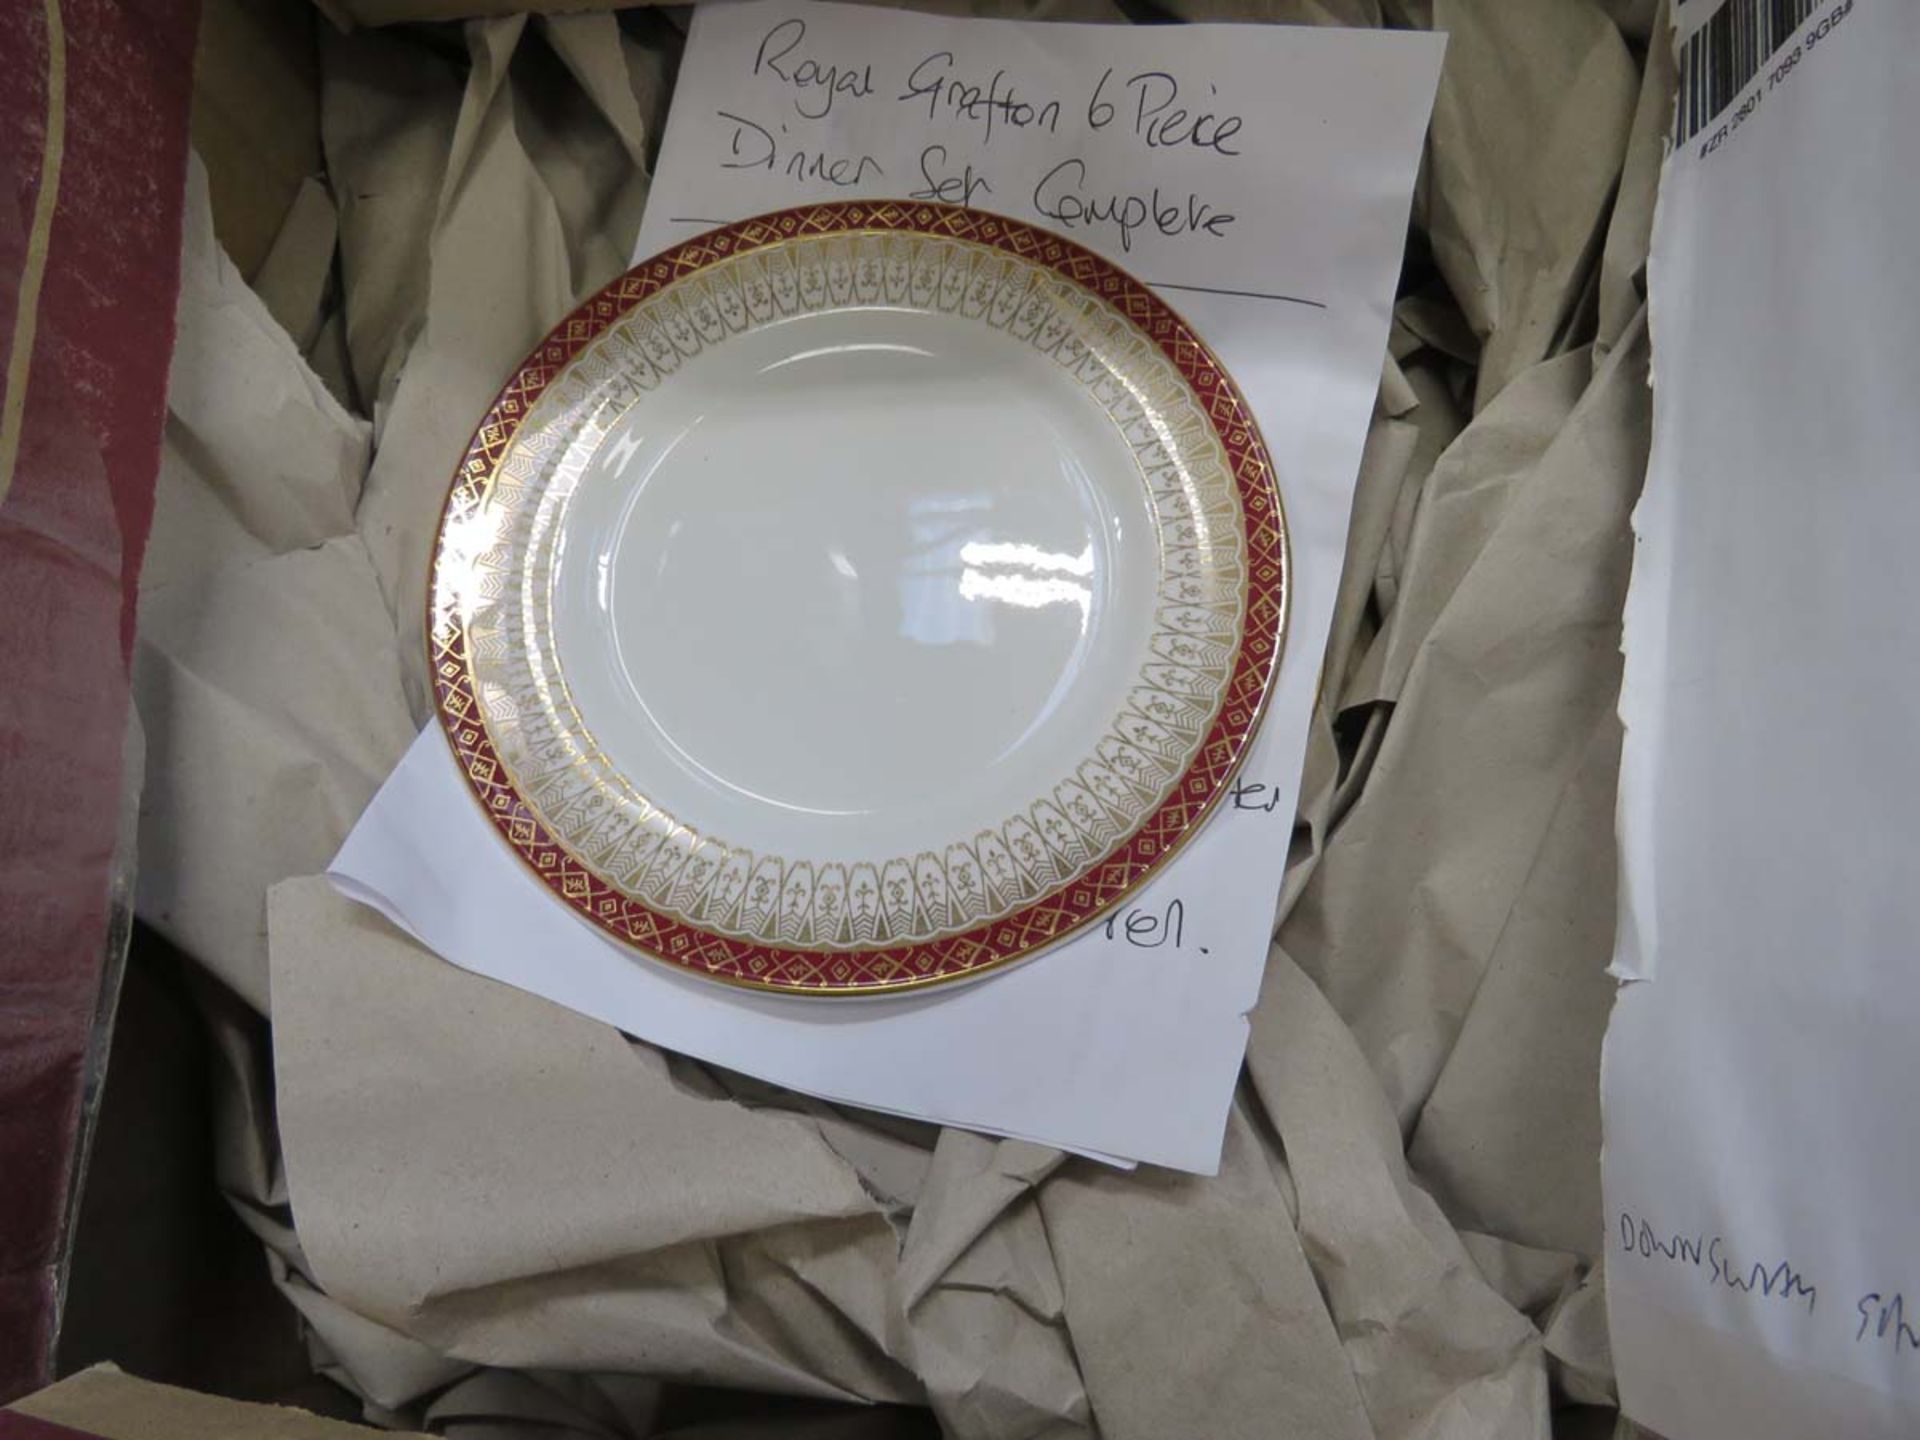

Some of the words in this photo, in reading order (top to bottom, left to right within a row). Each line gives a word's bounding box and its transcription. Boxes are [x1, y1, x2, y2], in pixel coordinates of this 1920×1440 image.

[755, 18, 874, 119] Royal
[898, 52, 1060, 146] Grafton
[1088, 68, 1115, 130] 6
[717, 110, 884, 187] Dinner
